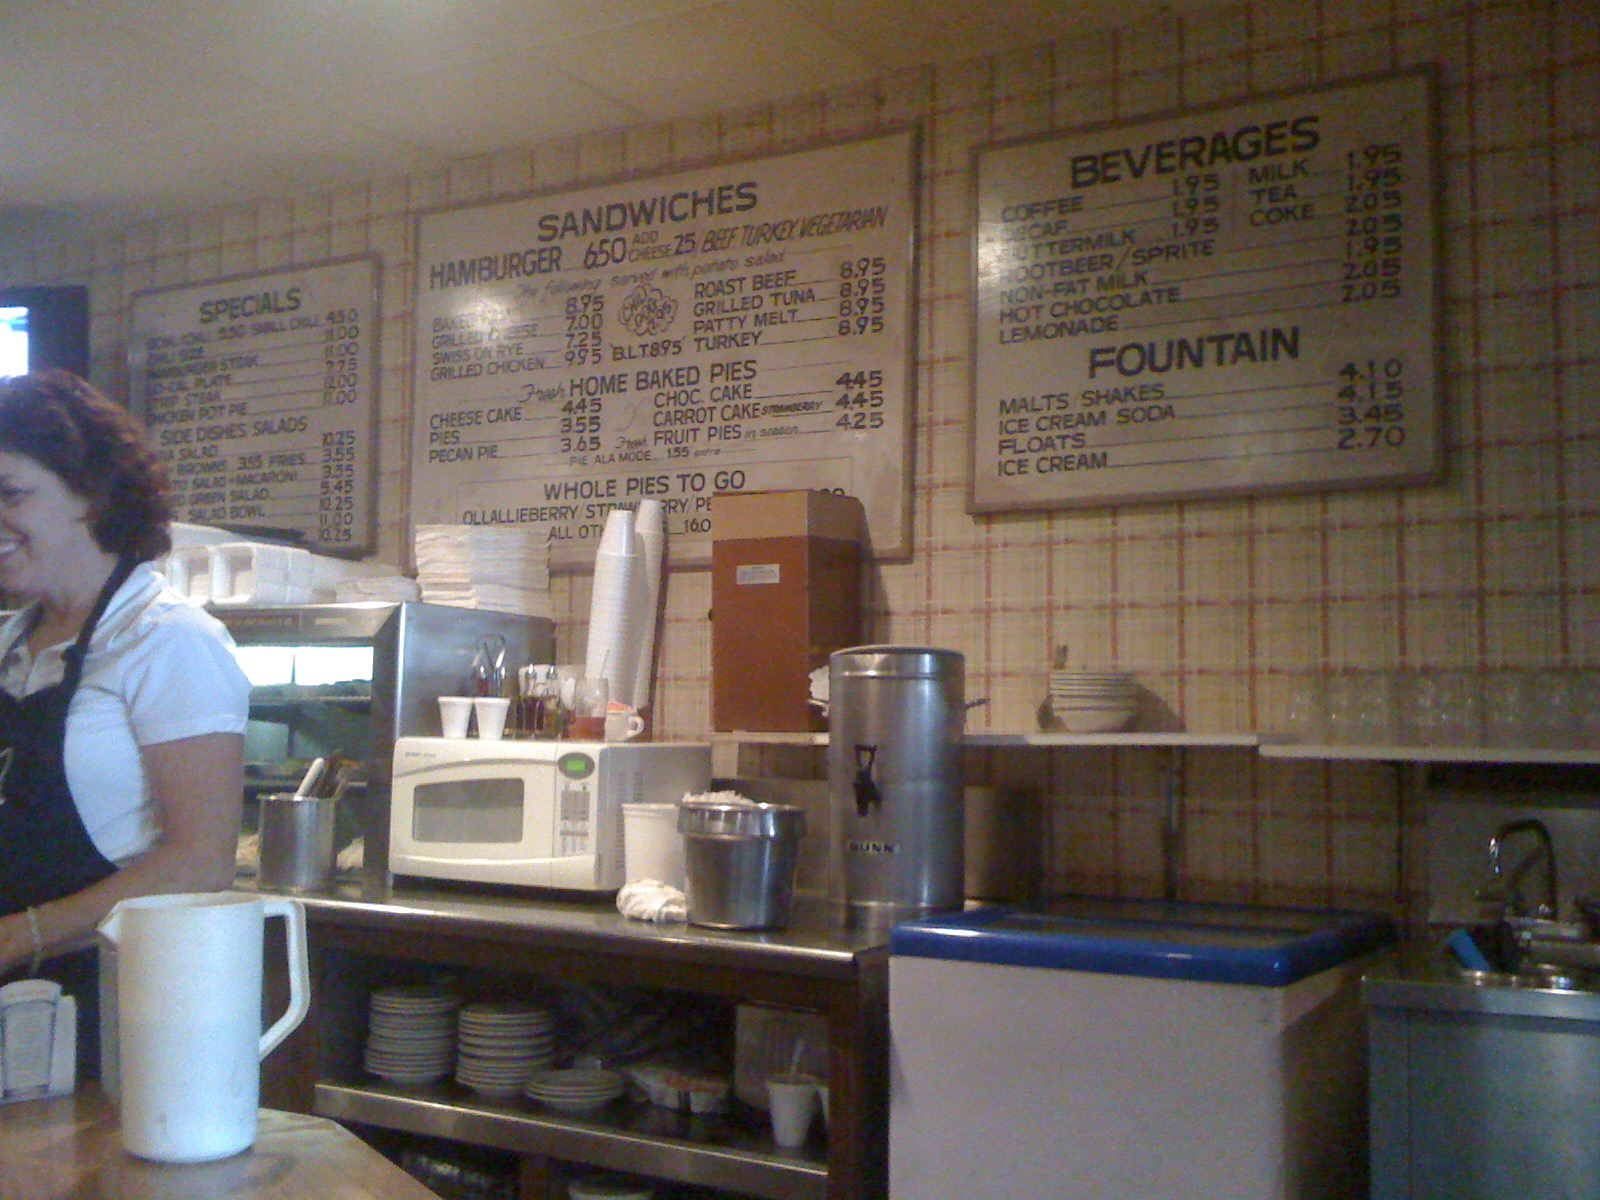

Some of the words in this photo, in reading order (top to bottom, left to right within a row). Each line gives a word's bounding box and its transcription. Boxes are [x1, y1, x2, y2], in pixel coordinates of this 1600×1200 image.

[1071, 116, 1320, 188] BEVERAGES
[1248, 158, 1309, 184] MILK
[1001, 195, 1083, 223] COFFEE
[1249, 184, 1298, 205] TEA
[537, 181, 758, 242] SANDWICHES
[1249, 202, 1315, 227] COKE
[701, 226, 739, 253] BEEF
[741, 218, 799, 247] TURKEY
[429, 246, 563, 290] HAMBURGER
[694, 277, 746, 298] ROAST
[752, 270, 797, 291] BEEF
[840, 257, 886, 279] 8.95
[1096, 270, 1149, 294] MILK
[199, 286, 301, 324] SPECIALS
[693, 295, 763, 317] GRILLED
[770, 288, 815, 306] TUNA
[840, 277, 886, 298] 8.95
[999, 303, 1043, 325] HOT
[1050, 286, 1180, 318] CHOCOLATE
[432, 330, 483, 349] GRILLED
[566, 313, 604, 332] 7.00
[693, 315, 747, 334] PATTY
[754, 309, 799, 328] MELT
[839, 296, 885, 317] 8.95
[999, 315, 1119, 345] LEMONADE
[432, 348, 471, 365] SWISS
[496, 342, 524, 358] RYE
[565, 330, 603, 349] 7.25
[693, 330, 763, 352] TURKEY
[838, 316, 884, 336] 8.95
[1088, 325, 1300, 379] FOUNTAIN
[194, 374, 232, 389] PLATE
[430, 363, 483, 381] GRILLED
[487, 357, 545, 375] CHICKEN
[570, 373, 629, 398] HOME
[636, 365, 700, 391] BAKED
[710, 360, 757, 383] PIES
[710, 384, 752, 403] CAKE
[835, 370, 883, 390] 4.45
[1000, 392, 1069, 415] MALTS
[1081, 382, 1165, 407] SHAKES
[1338, 357, 1403, 381] 4.10
[199, 404, 225, 419] POT
[228, 401, 248, 416] PIE
[430, 410, 482, 430] CHEESE
[487, 406, 523, 423] CAKE
[561, 397, 602, 415] 4.45
[653, 406, 717, 427] CARROT
[720, 402, 760, 421] CAKE
[835, 390, 884, 410] 4.45
[999, 418, 1029, 436] ICE
[1036, 410, 1106, 433] CREAM
[1116, 404, 1176, 425] SODA
[1338, 380, 1404, 402] 4.15
[160, 428, 193, 446] SIDE
[195, 422, 246, 442] DISHES
[252, 415, 308, 437] SALADS
[430, 430, 460, 446] PIES
[654, 427, 700, 446] FRUIT
[707, 424, 742, 441] PIES
[998, 432, 1087, 456] FLOATS
[1338, 403, 1404, 425] 3.45
[176, 459, 228, 476] BROWNS
[268, 452, 306, 468] FRIES
[178, 444, 219, 461] SALAD
[428, 446, 473, 463] PECAN
[477, 445, 498, 460] PIE
[560, 436, 602, 453] 3.65
[569, 454, 588, 466] PIE
[618, 450, 651, 463] MODE
[997, 458, 1029, 476] ICE
[1036, 450, 1108, 474] CREAM
[1337, 425, 1406, 450] 2.70
[189, 491, 226, 506] GREEN
[229, 487, 270, 503] SALAD
[544, 479, 617, 501] WHOLE
[626, 475, 670, 497] PIES
[676, 473, 705, 493] TO
[714, 470, 746, 490] GO
[188, 506, 227, 522] SALAD
[230, 505, 265, 520] BOWL
[549, 525, 573, 540] ALL
